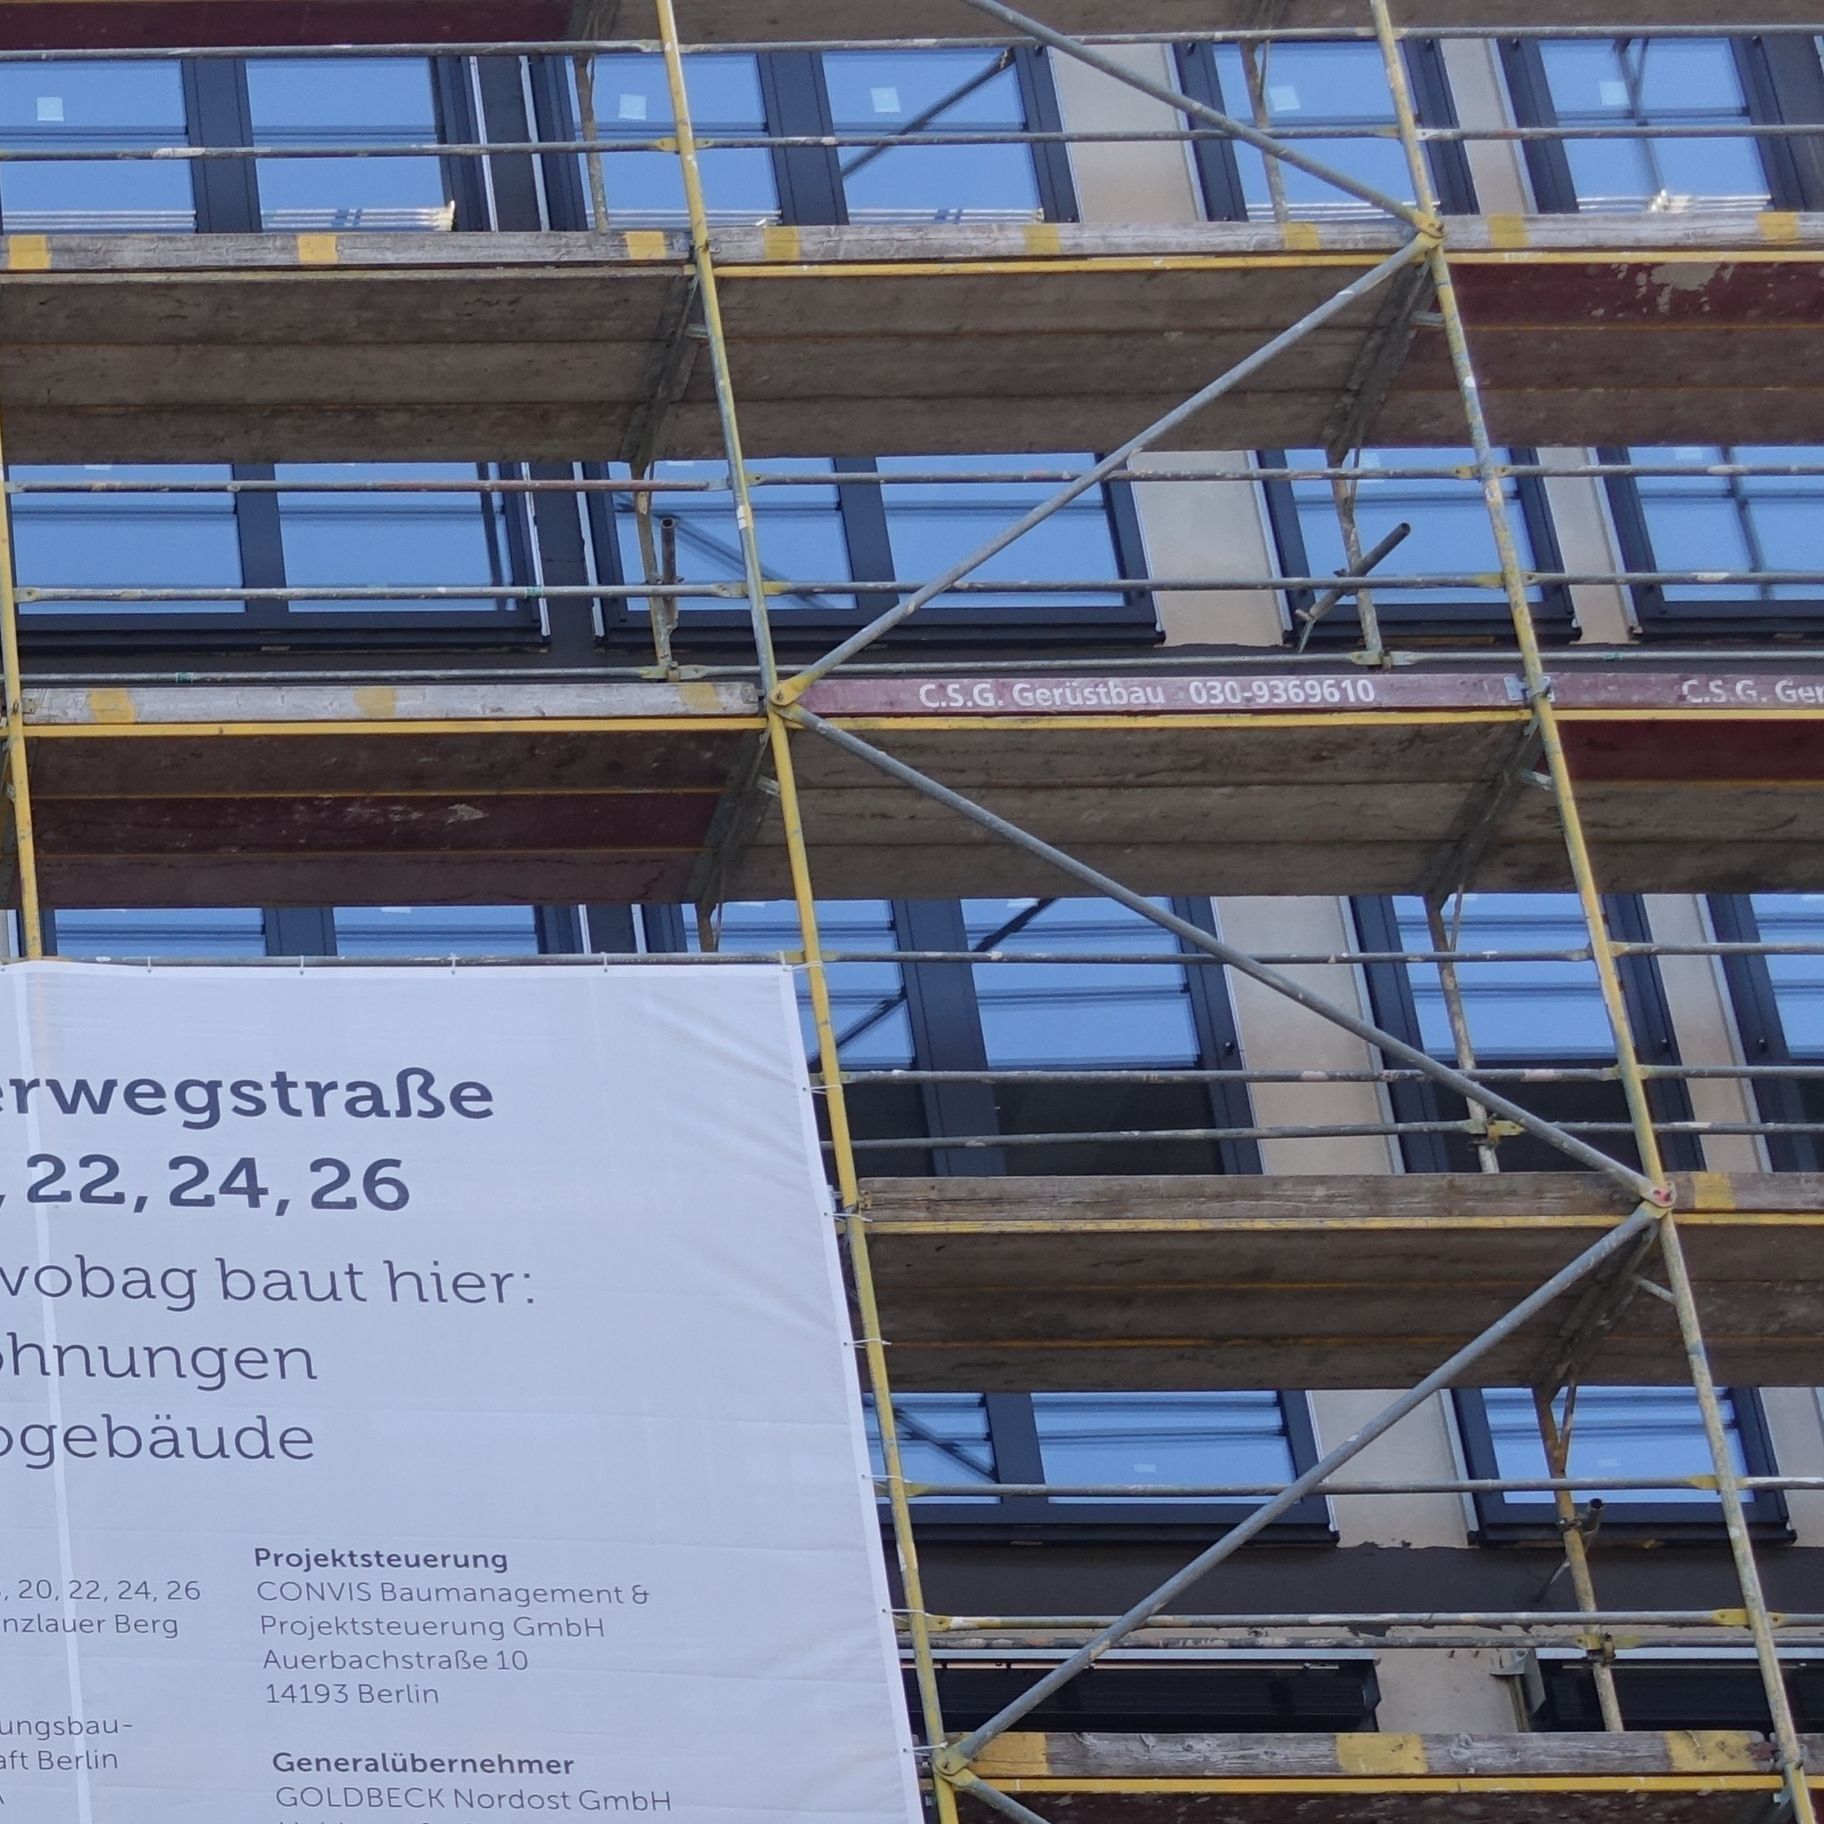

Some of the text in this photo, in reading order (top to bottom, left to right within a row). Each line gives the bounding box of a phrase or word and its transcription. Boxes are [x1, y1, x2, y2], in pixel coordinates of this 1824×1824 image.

[919, 678, 1376, 708] C.S.G. Gerüstbau 030-9369610
[1682, 679, 1768, 704] C.S.G.
[26, 1153, 149, 1214] 22,
[168, 1155, 291, 1217] 24,
[309, 1157, 410, 1212] 26
[214, 1257, 368, 1303] baut
[382, 1259, 534, 1304] hier:
[254, 1547, 508, 1574] Projektsteuerung
[18, 1579, 60, 1602] 20,
[68, 1579, 109, 1603] 22,
[117, 1579, 158, 1603] 24,
[166, 1580, 201, 1601] 26
[257, 1580, 651, 1608] CONVIS Baumanagement &
[114, 1614, 178, 1639] Berg
[260, 1614, 605, 1642] Projektsteuerung GmbH
[262, 1649, 529, 1671] Auerbachstraße 10
[266, 1683, 439, 1704] 14193 Berlin
[37, 1749, 118, 1771] Berlin
[272, 1751, 575, 1775] Generalübernehmer
[275, 1786, 671, 1812] GOLDBECK Nordost GmbH
